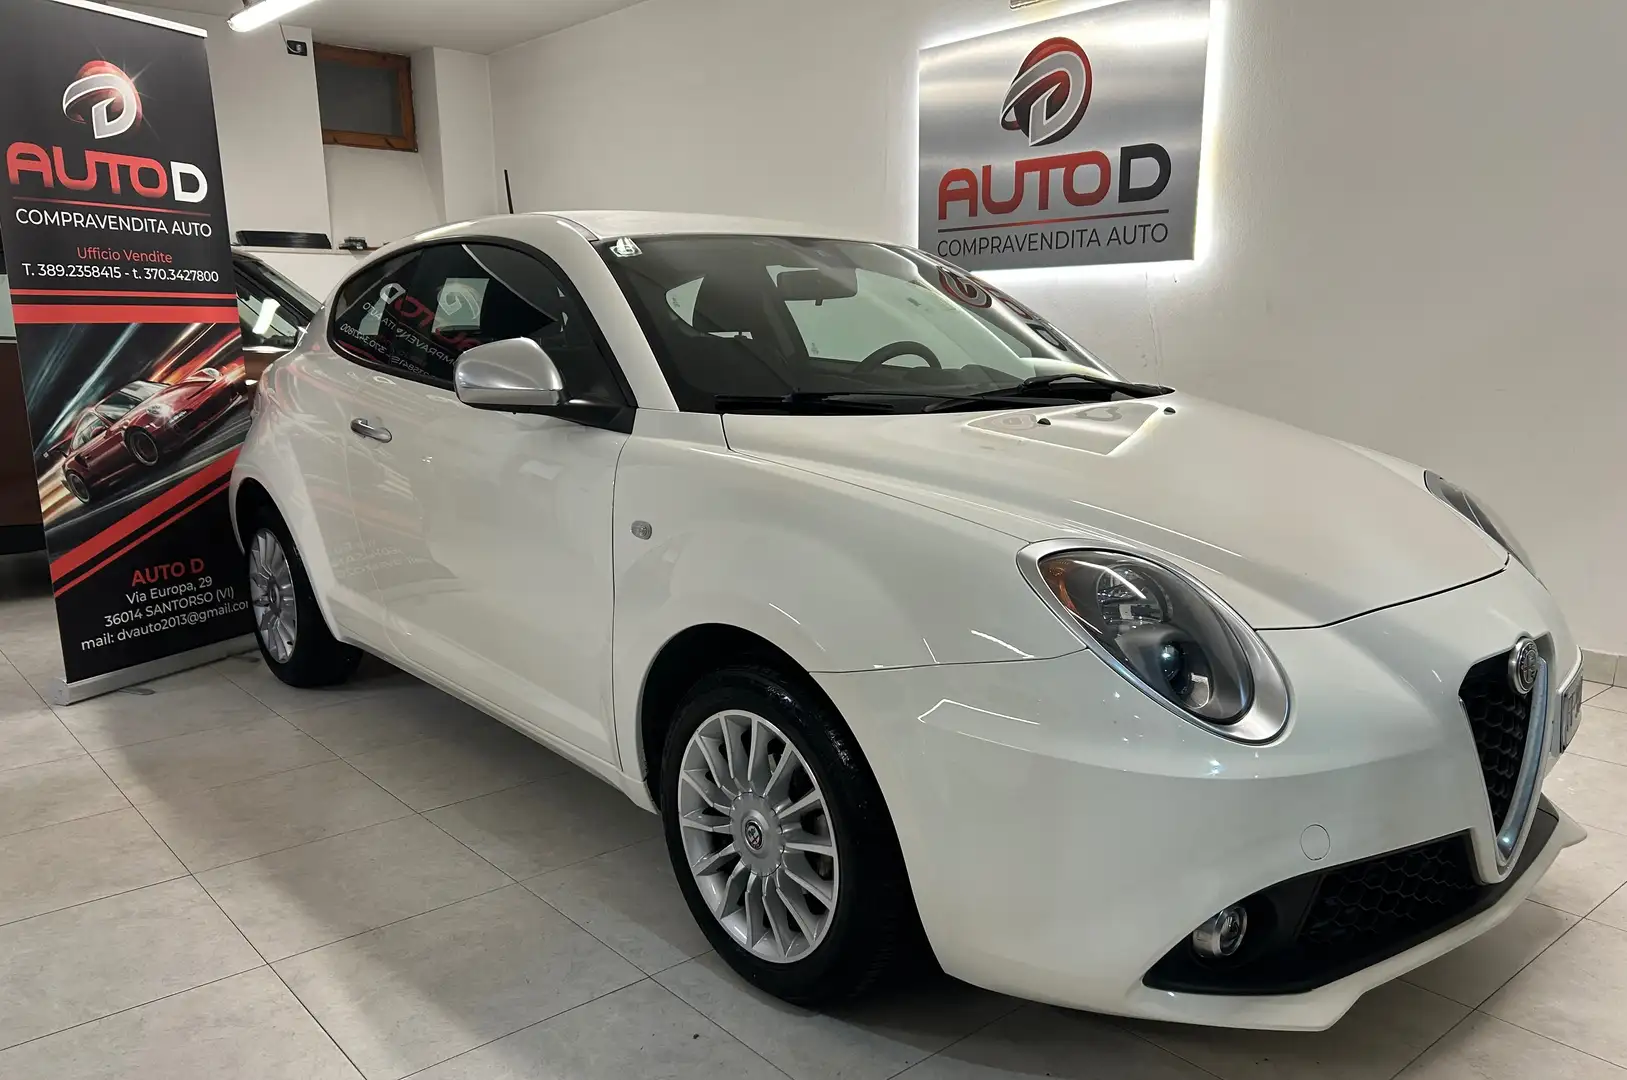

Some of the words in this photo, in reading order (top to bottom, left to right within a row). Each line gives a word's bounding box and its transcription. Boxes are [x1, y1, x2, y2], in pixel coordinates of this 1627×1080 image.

[15, 208, 169, 234] COMPRAVENDITA
[171, 221, 212, 237] AUTO
[77, 246, 120, 261] Ufficio
[123, 249, 173, 263] Vendite
[937, 227, 1101, 257] COMPRAVENDITA
[1106, 223, 1169, 247] AUTO
[21, 263, 35, 276] T.
[38, 264, 122, 279] 389.2358415
[132, 267, 142, 280] t.
[144, 268, 219, 282] 370.3427800
[131, 561, 186, 588] AUTO
[190, 558, 205, 574] D
[125, 591, 148, 605] Via
[150, 580, 197, 600] Europa,
[198, 576, 213, 588] 29
[103, 608, 143, 628] 36014
[145, 591, 213, 618] SANTORSO
[216, 586, 235, 603] (VI)
[80, 632, 115, 651] mail:
